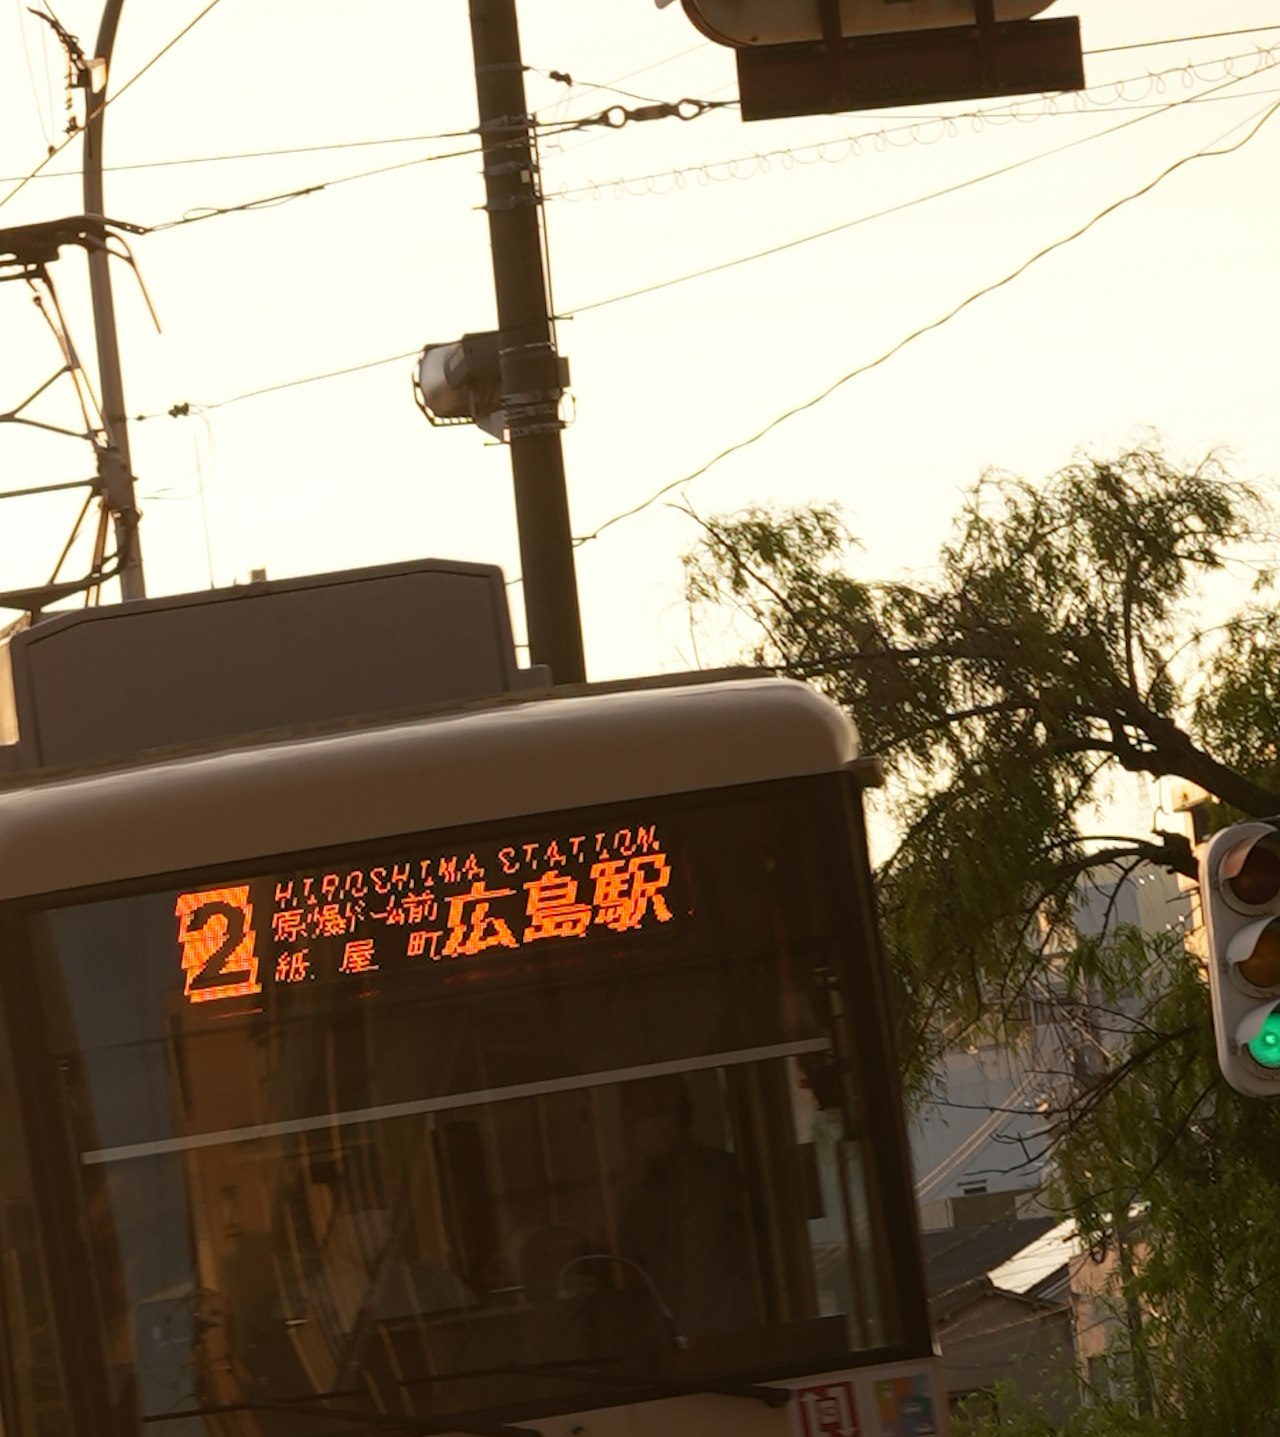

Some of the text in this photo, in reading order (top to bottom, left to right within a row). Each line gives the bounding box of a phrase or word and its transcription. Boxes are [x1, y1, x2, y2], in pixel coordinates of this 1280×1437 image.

[273, 824, 662, 904] HIROSHIMA STATION
[440, 852, 674, 957] 広島駅
[181, 895, 260, 994] 2
